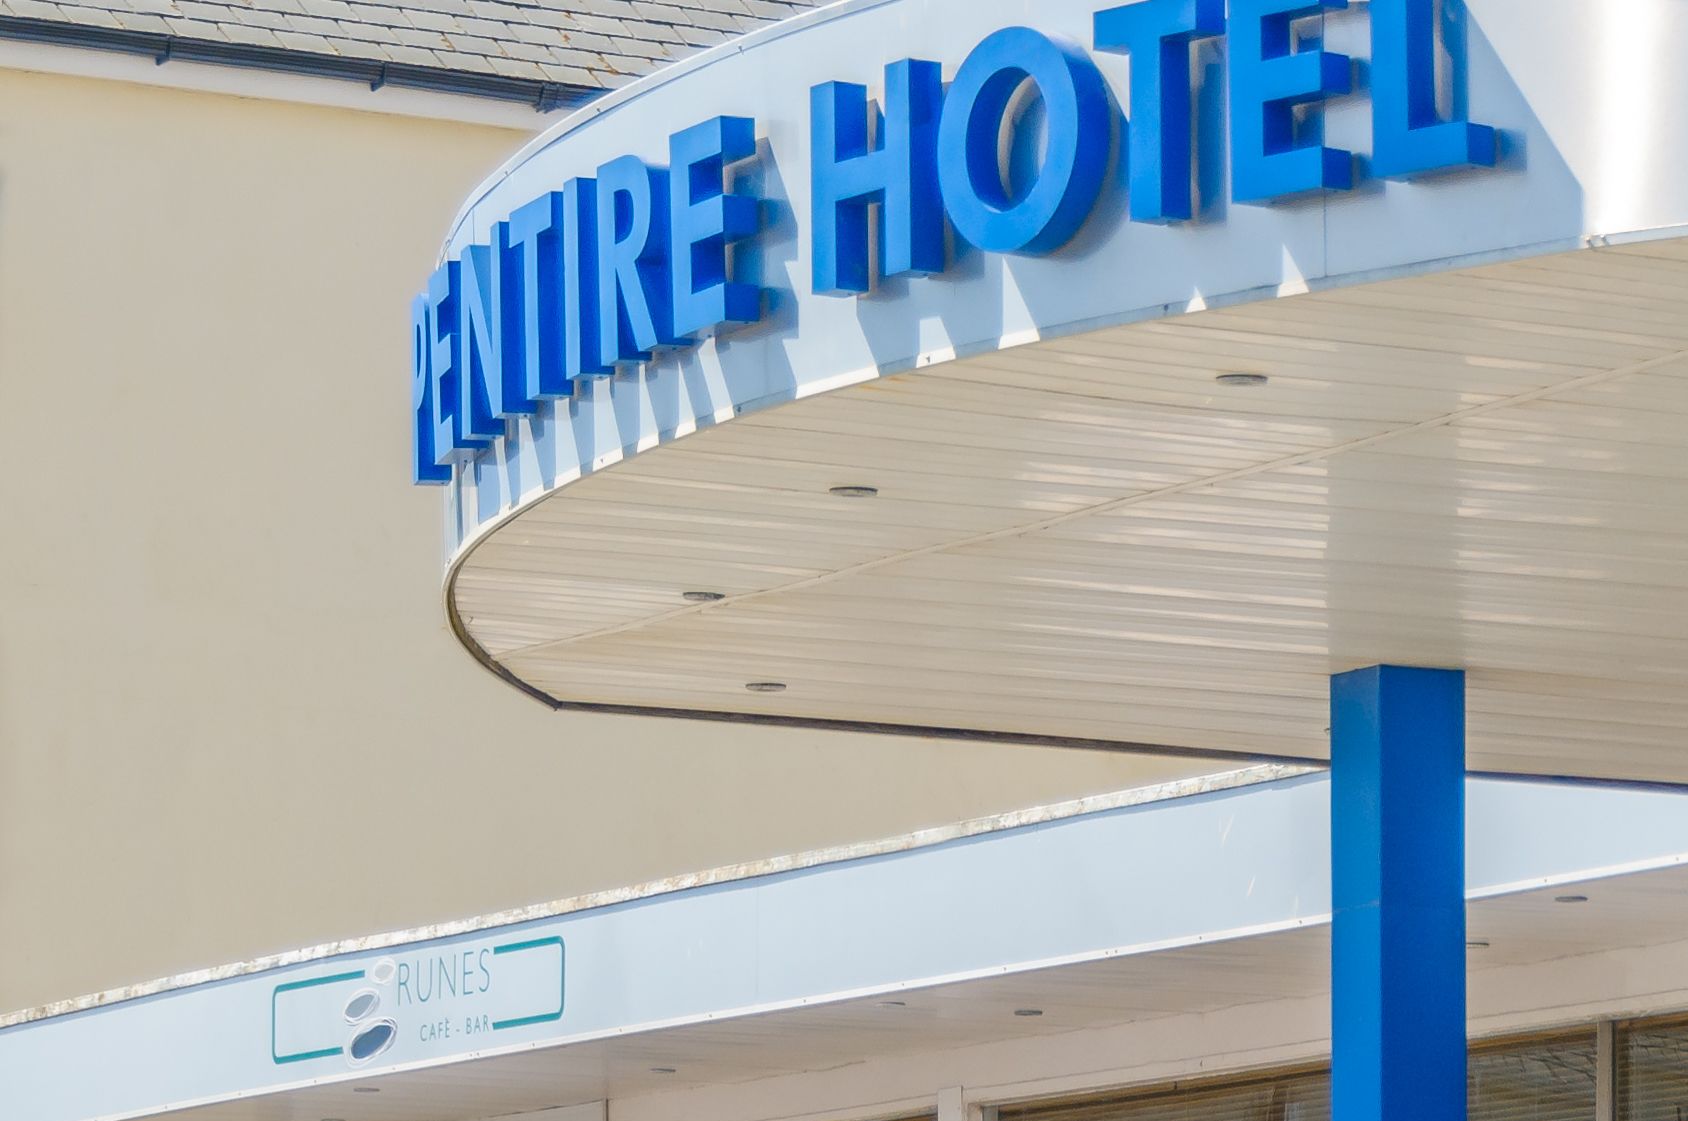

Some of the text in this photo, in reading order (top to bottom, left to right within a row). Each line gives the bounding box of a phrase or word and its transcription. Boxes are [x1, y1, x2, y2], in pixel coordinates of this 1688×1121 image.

[412, 0, 1495, 485] PENTIRE HOTEL
[398, 948, 490, 1007] RUNES
[465, 1014, 490, 1034] BAR
